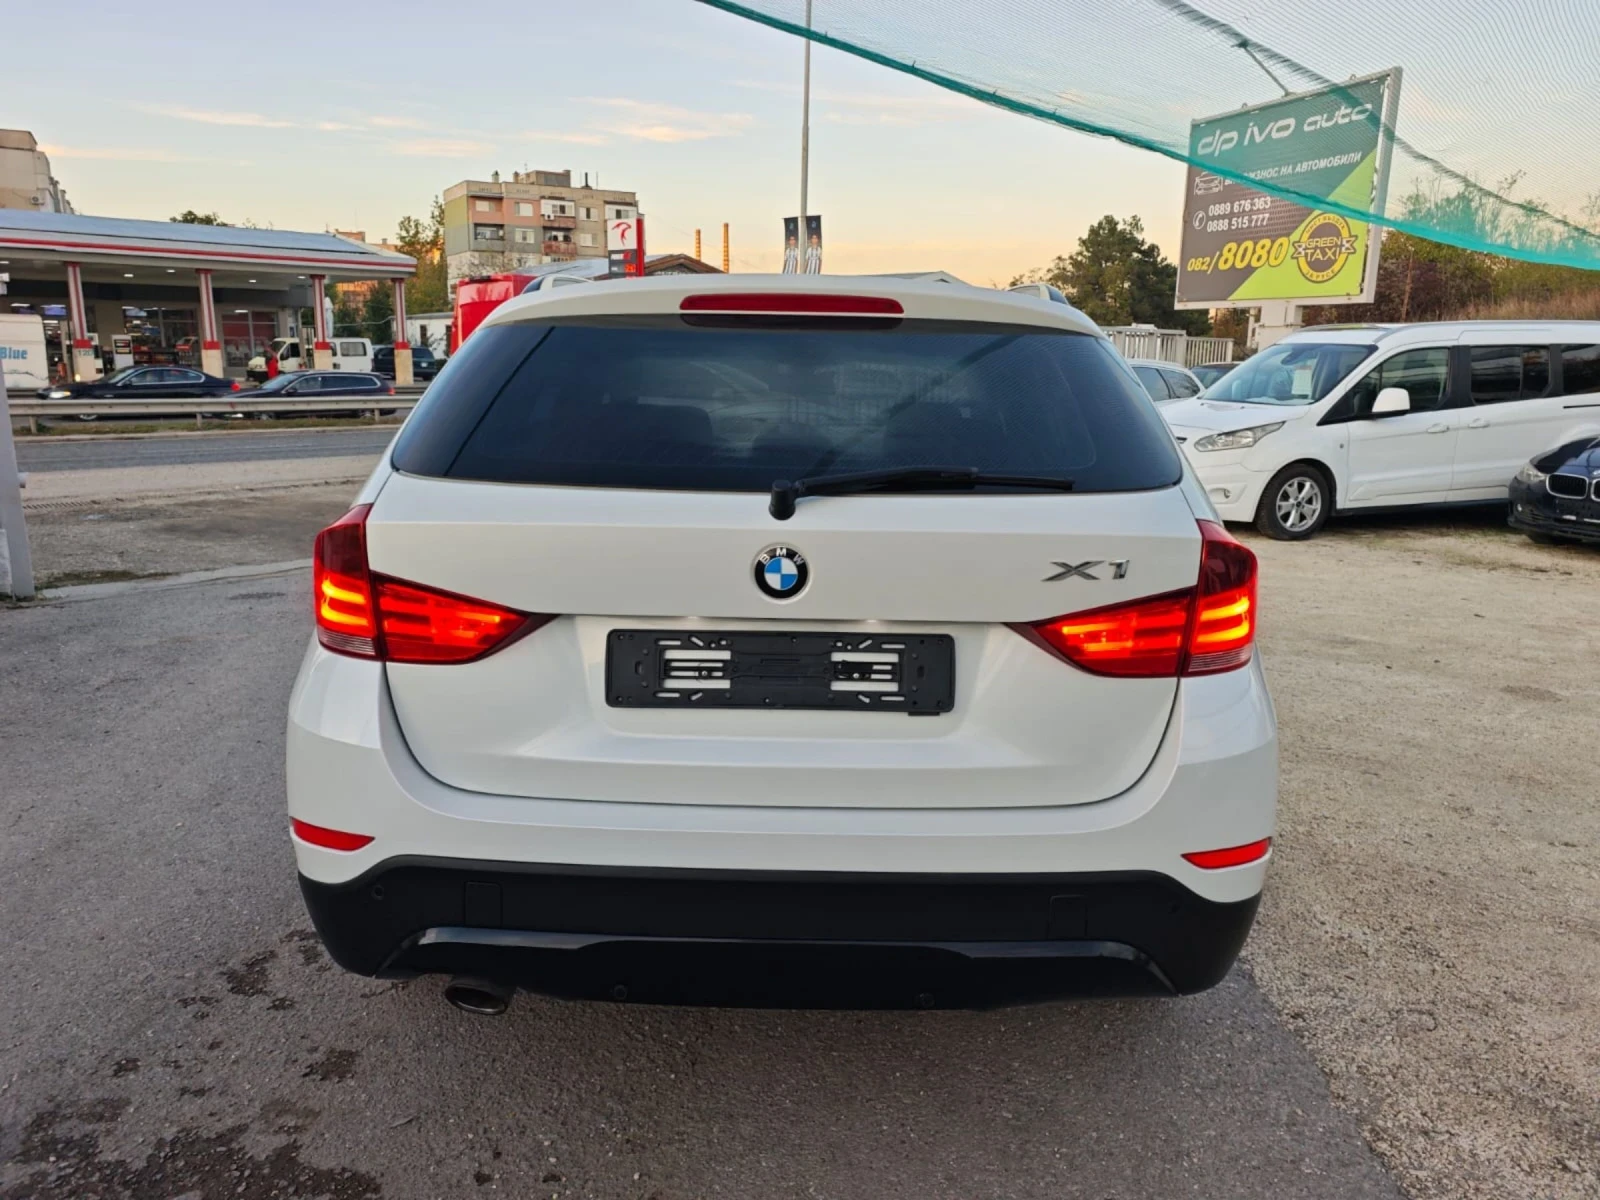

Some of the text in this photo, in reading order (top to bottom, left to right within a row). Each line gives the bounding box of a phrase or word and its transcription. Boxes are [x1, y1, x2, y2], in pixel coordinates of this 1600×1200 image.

[1197, 103, 1372, 157] dp ivo auto
[1281, 165, 1293, 176] НА
[1295, 151, 1362, 174] АВТОМОБИЛИ
[1208, 196, 1271, 217] 0889 676 363
[1206, 213, 1270, 232] 0888 515 777
[1306, 236, 1342, 248] GREEN
[1305, 247, 1341, 262] TAXI
[759, 547, 805, 566] BMW
[1040, 559, 1130, 582] X1
